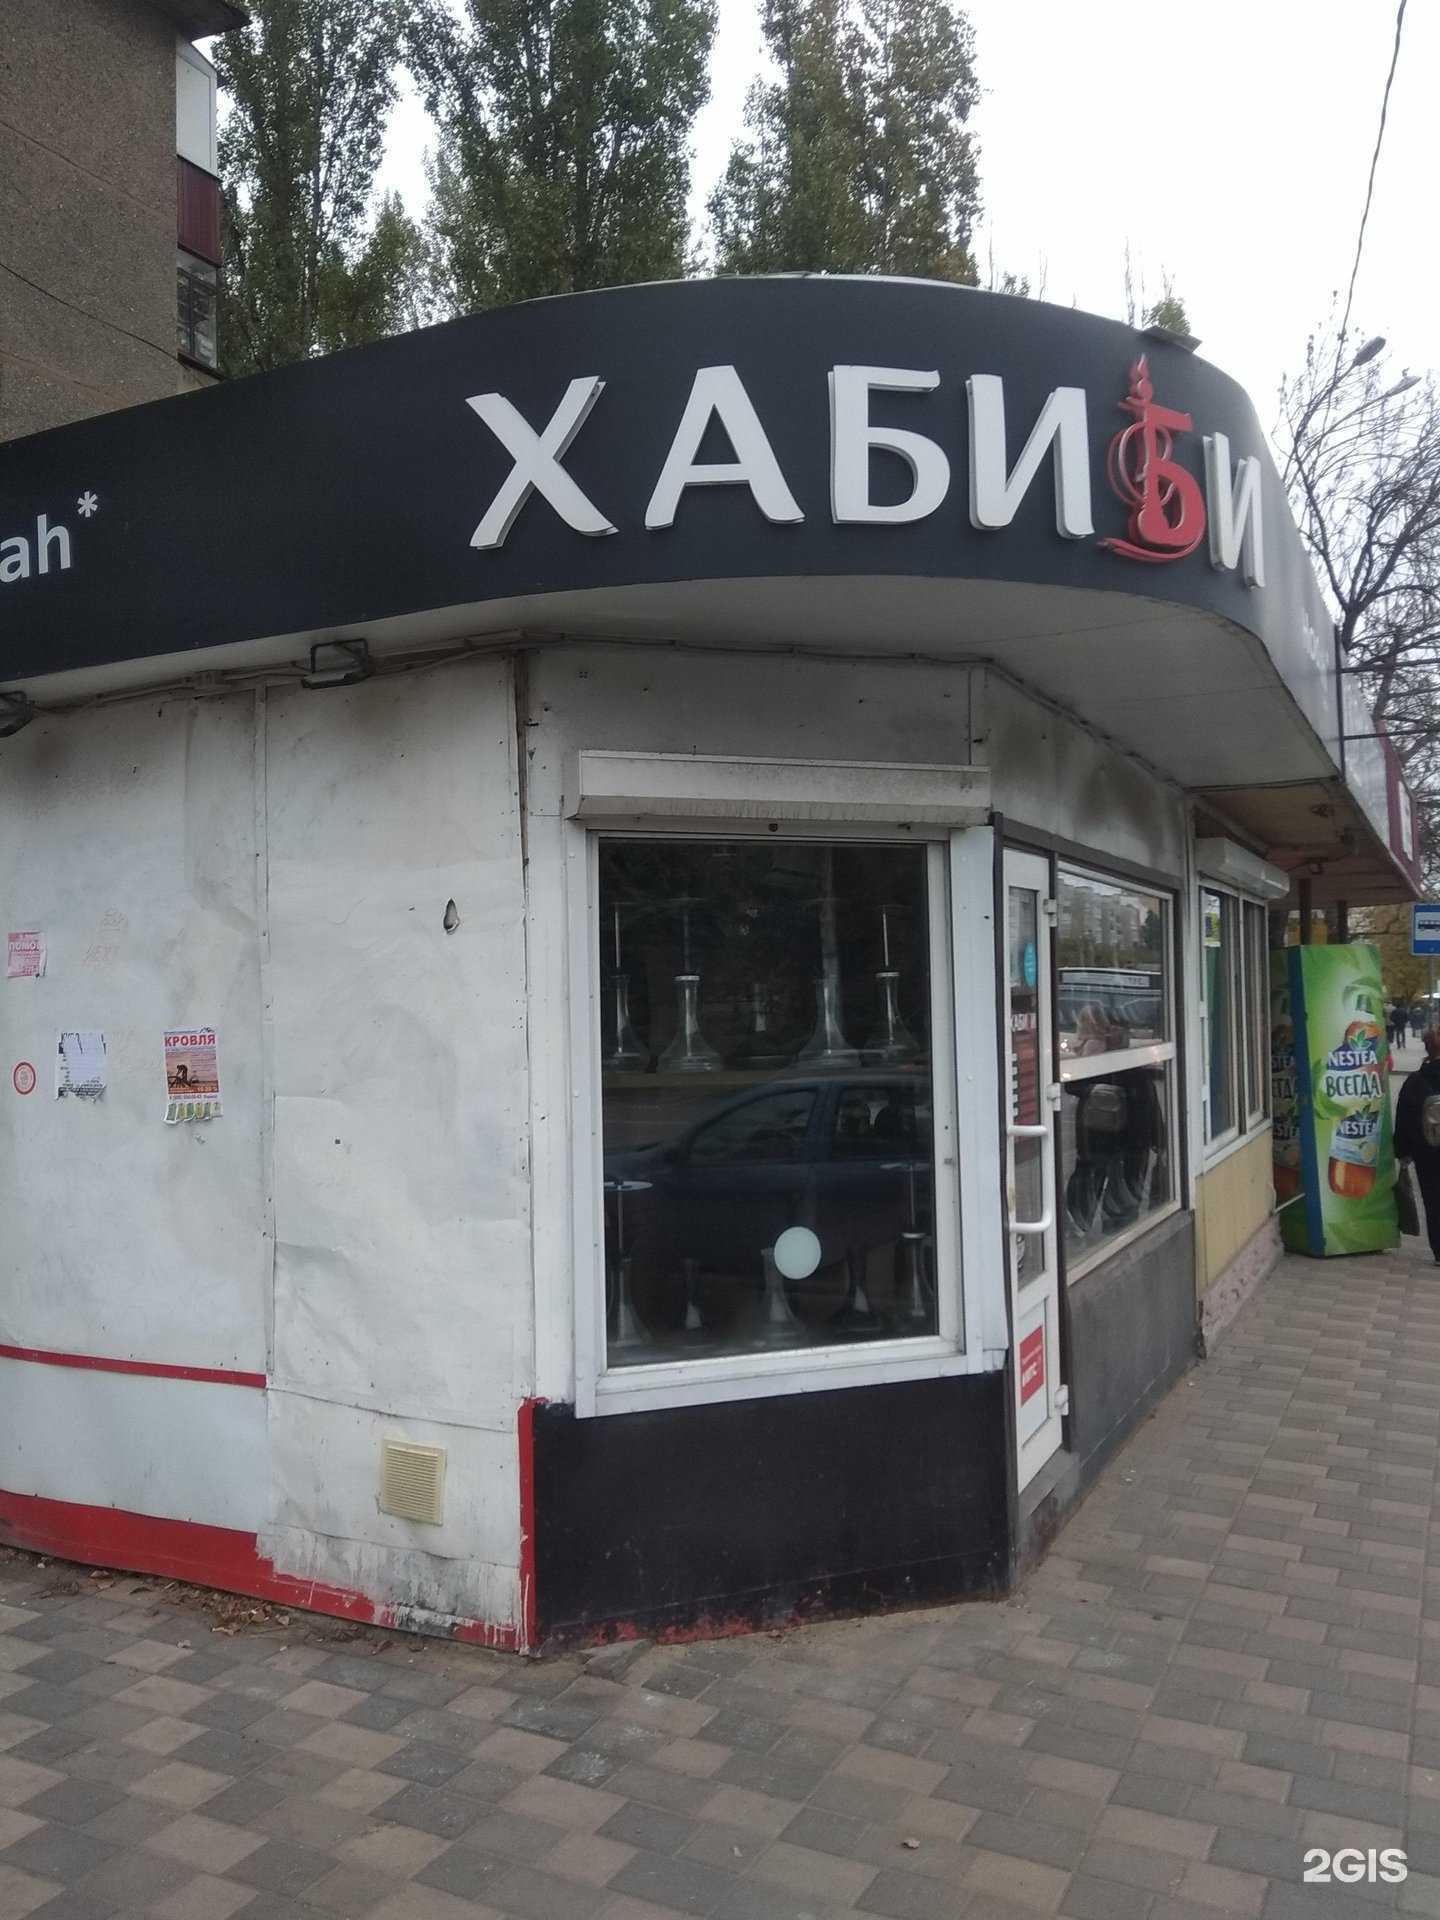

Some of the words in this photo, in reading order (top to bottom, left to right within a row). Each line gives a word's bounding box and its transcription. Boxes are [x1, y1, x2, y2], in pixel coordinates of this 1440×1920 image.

[465, 353, 1265, 590] ХАБИБИ
[164, 1034, 216, 1047] КРОВЛЯ
[1327, 1050, 1378, 1067] NESTEA
[1325, 1072, 1383, 1098] ВСЕГДА
